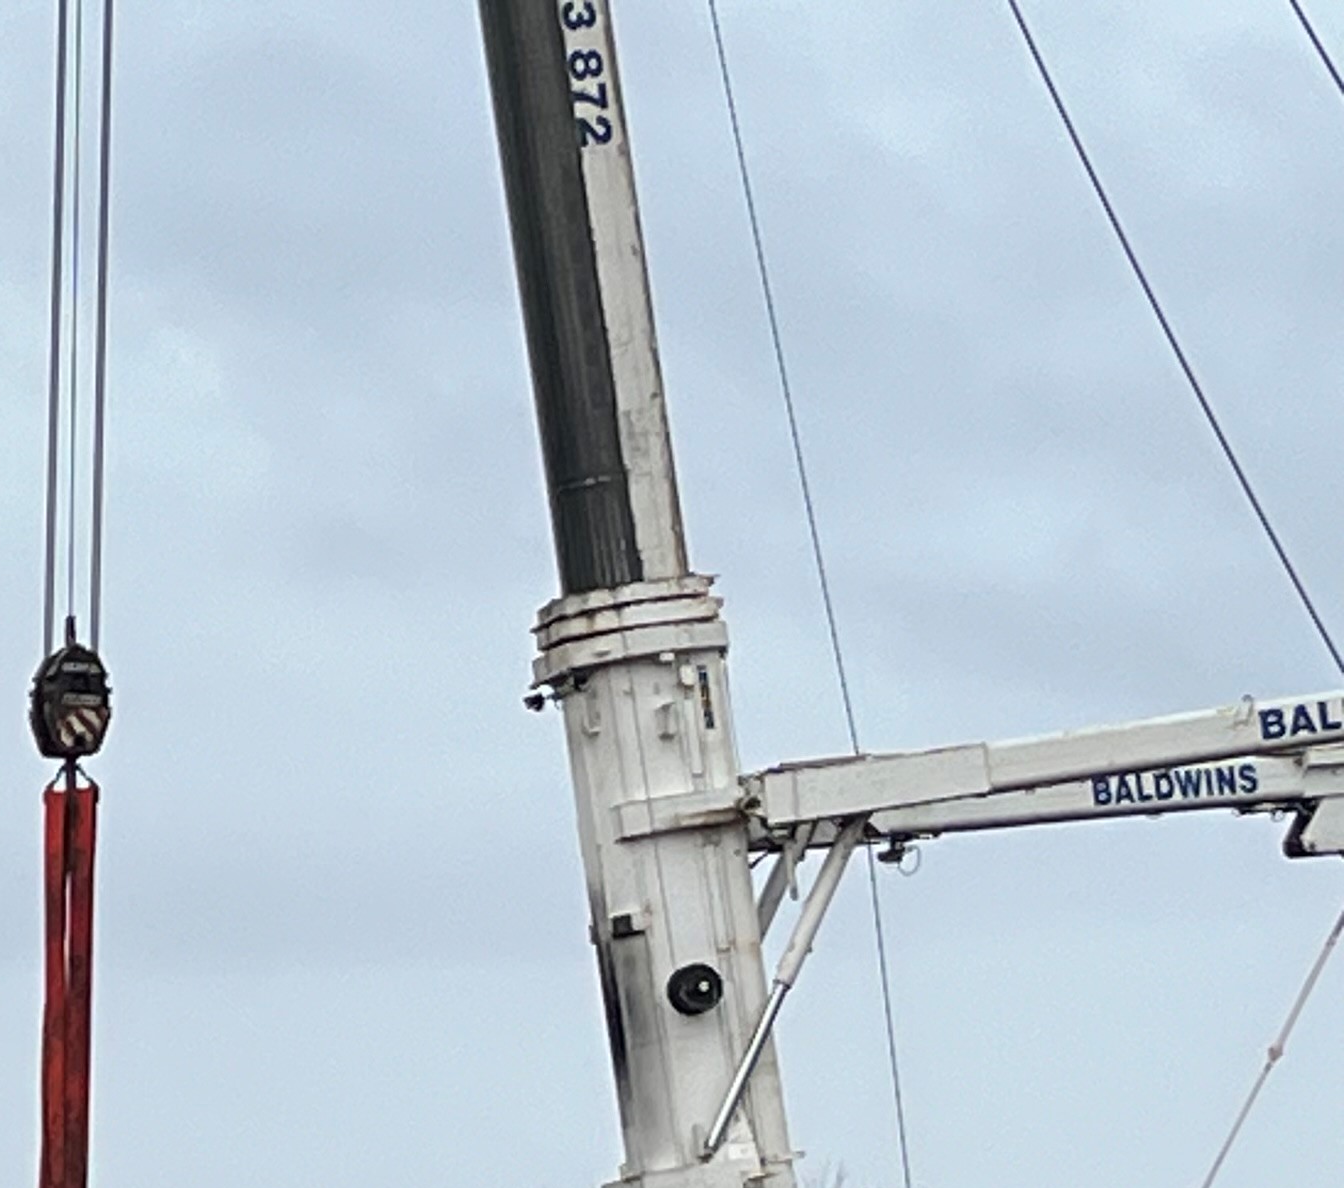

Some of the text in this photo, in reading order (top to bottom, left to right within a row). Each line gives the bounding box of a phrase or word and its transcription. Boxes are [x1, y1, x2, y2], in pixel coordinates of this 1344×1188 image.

[568, 48, 612, 148] 872
[1258, 696, 1344, 740] BAL
[1091, 764, 1259, 806] BALDWINS
